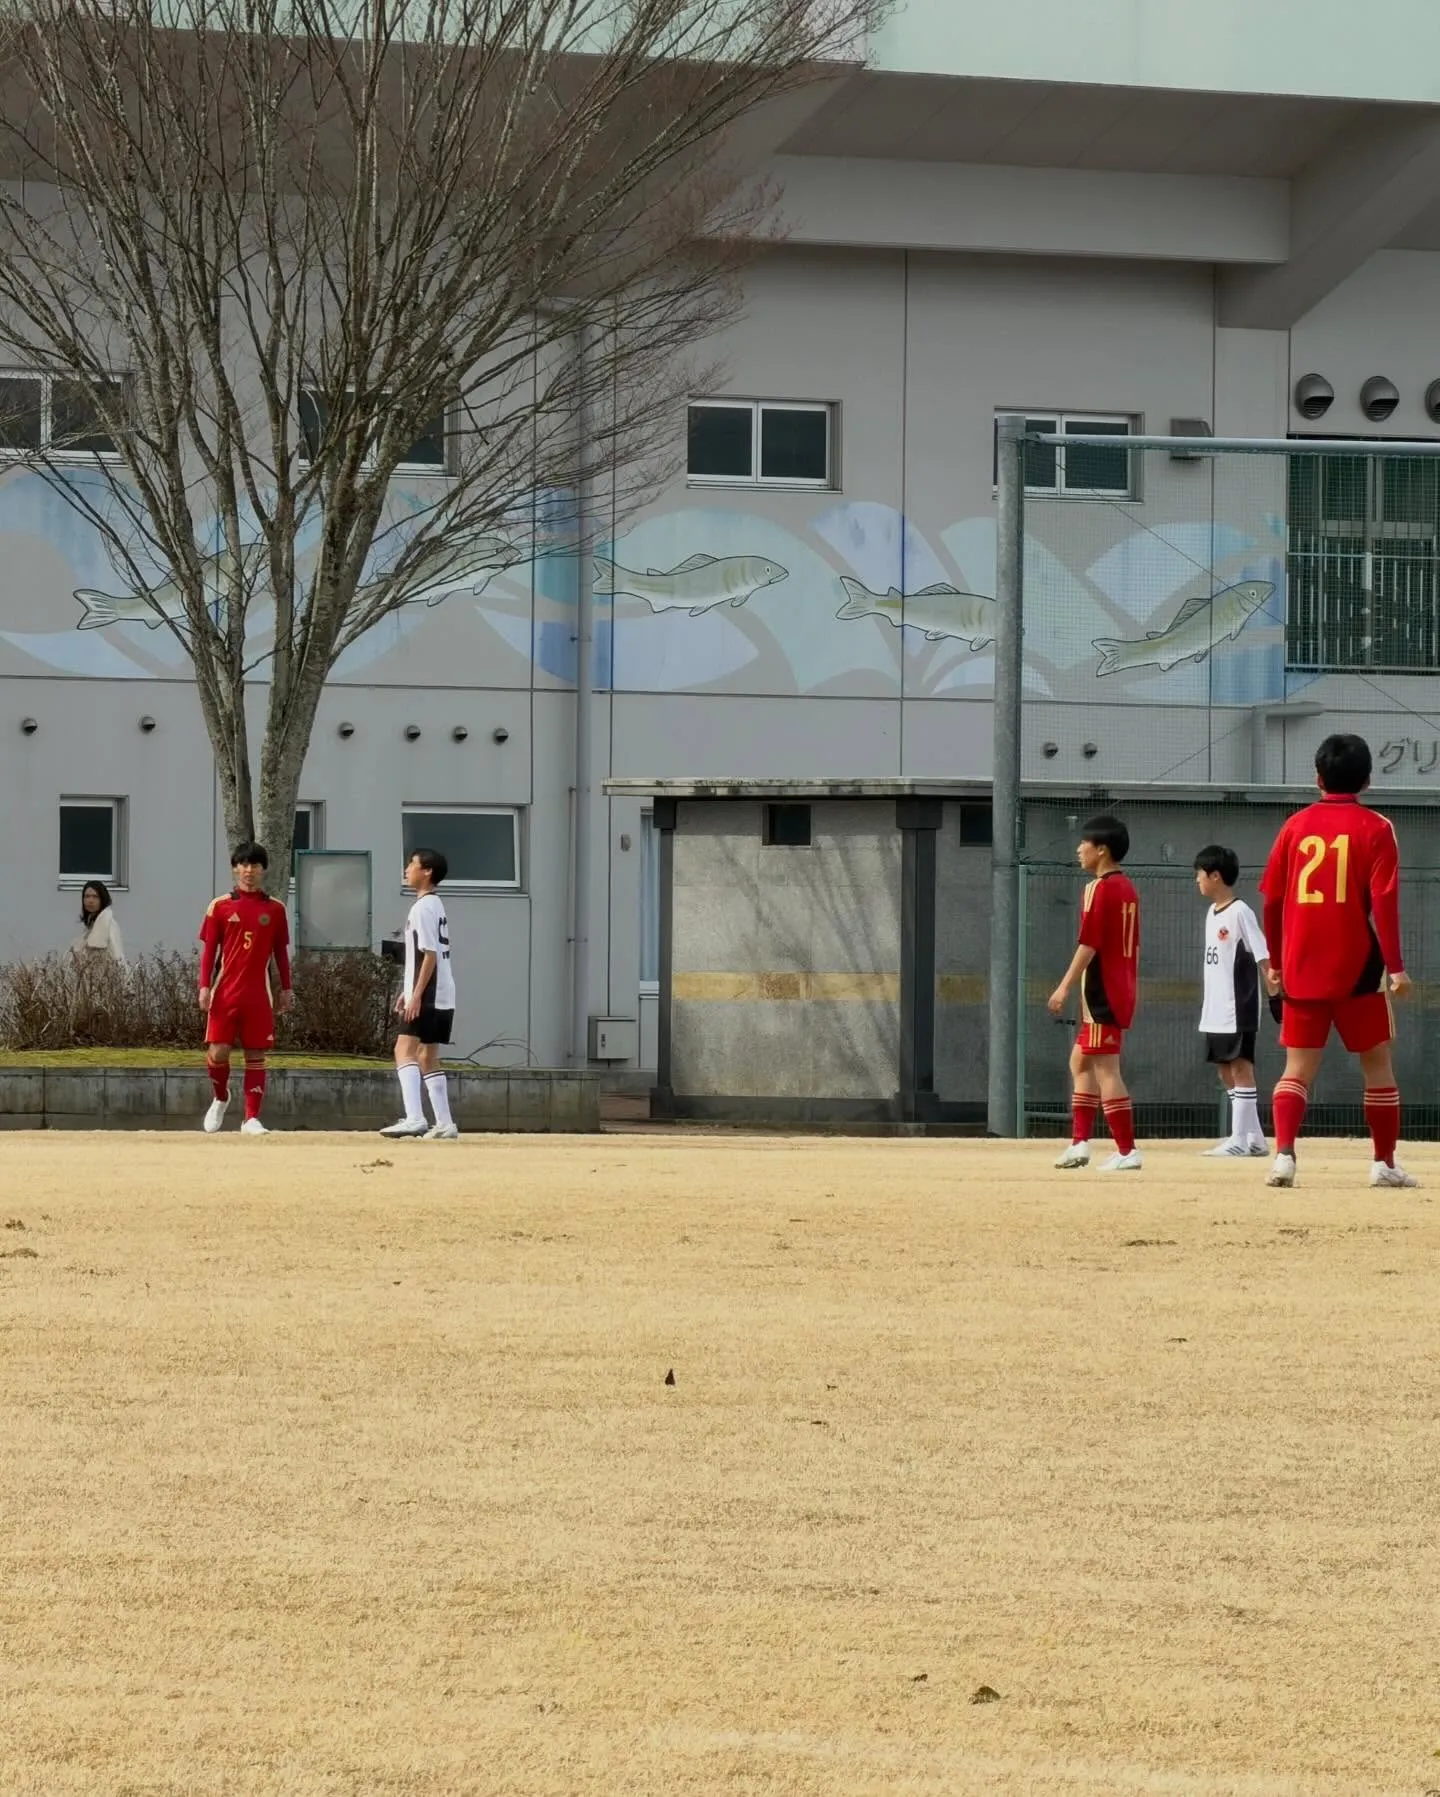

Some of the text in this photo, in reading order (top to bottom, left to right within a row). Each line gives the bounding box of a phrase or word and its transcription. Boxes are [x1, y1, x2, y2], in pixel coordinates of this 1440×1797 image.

[1379, 737, 1438, 774] グリ
[1297, 834, 1350, 904] 21
[243, 931, 253, 950] 5
[1206, 946, 1219, 965] 66
